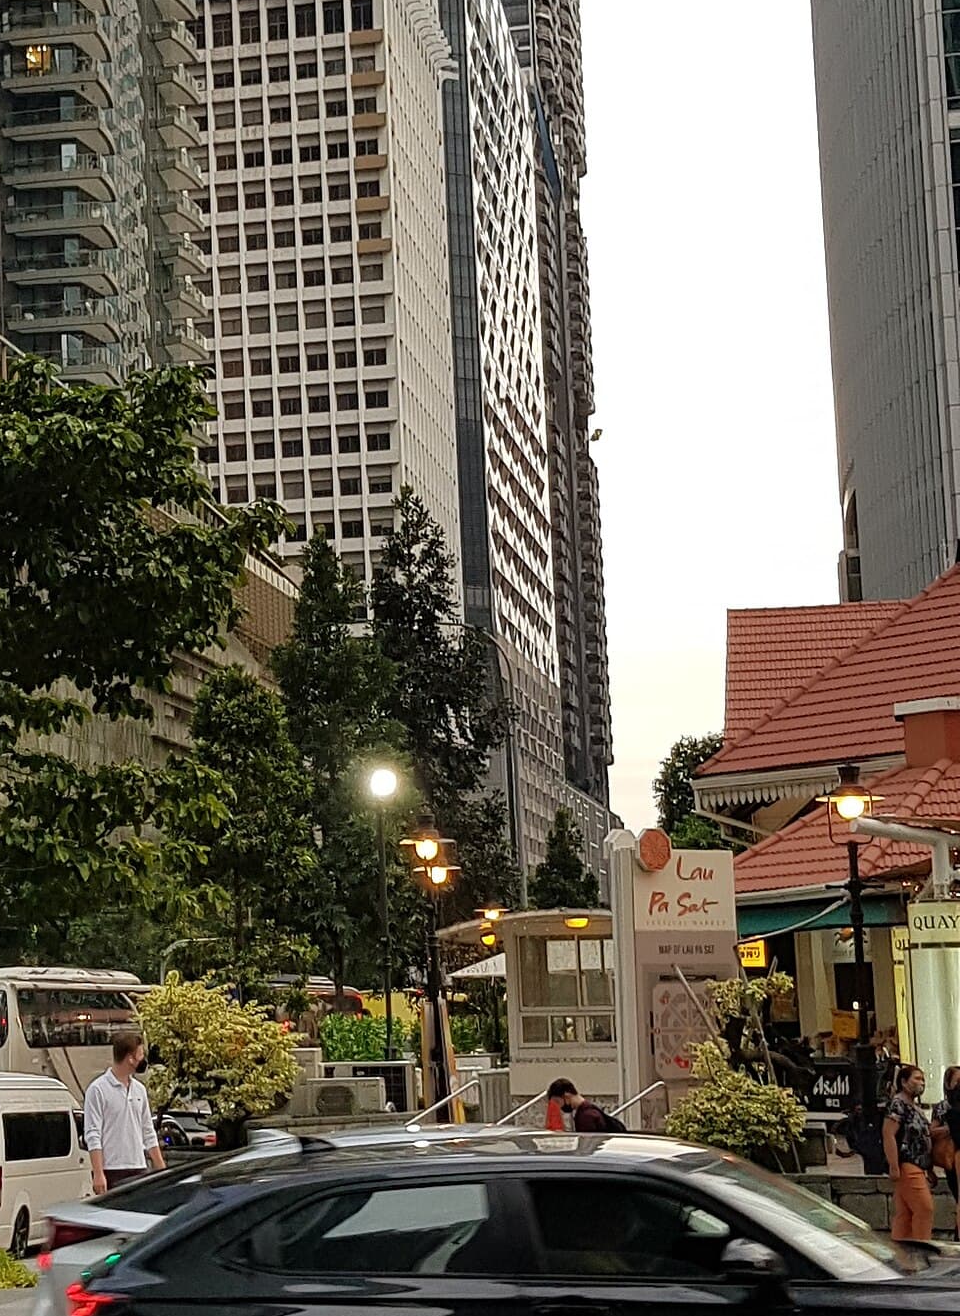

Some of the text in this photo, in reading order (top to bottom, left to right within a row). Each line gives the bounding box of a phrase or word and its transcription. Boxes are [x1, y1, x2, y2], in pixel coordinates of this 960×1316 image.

[676, 855, 714, 881] Lau
[648, 890, 719, 917] Pa Sat
[913, 914, 960, 931] QUAY
[813, 1075, 850, 1096] Asahi
